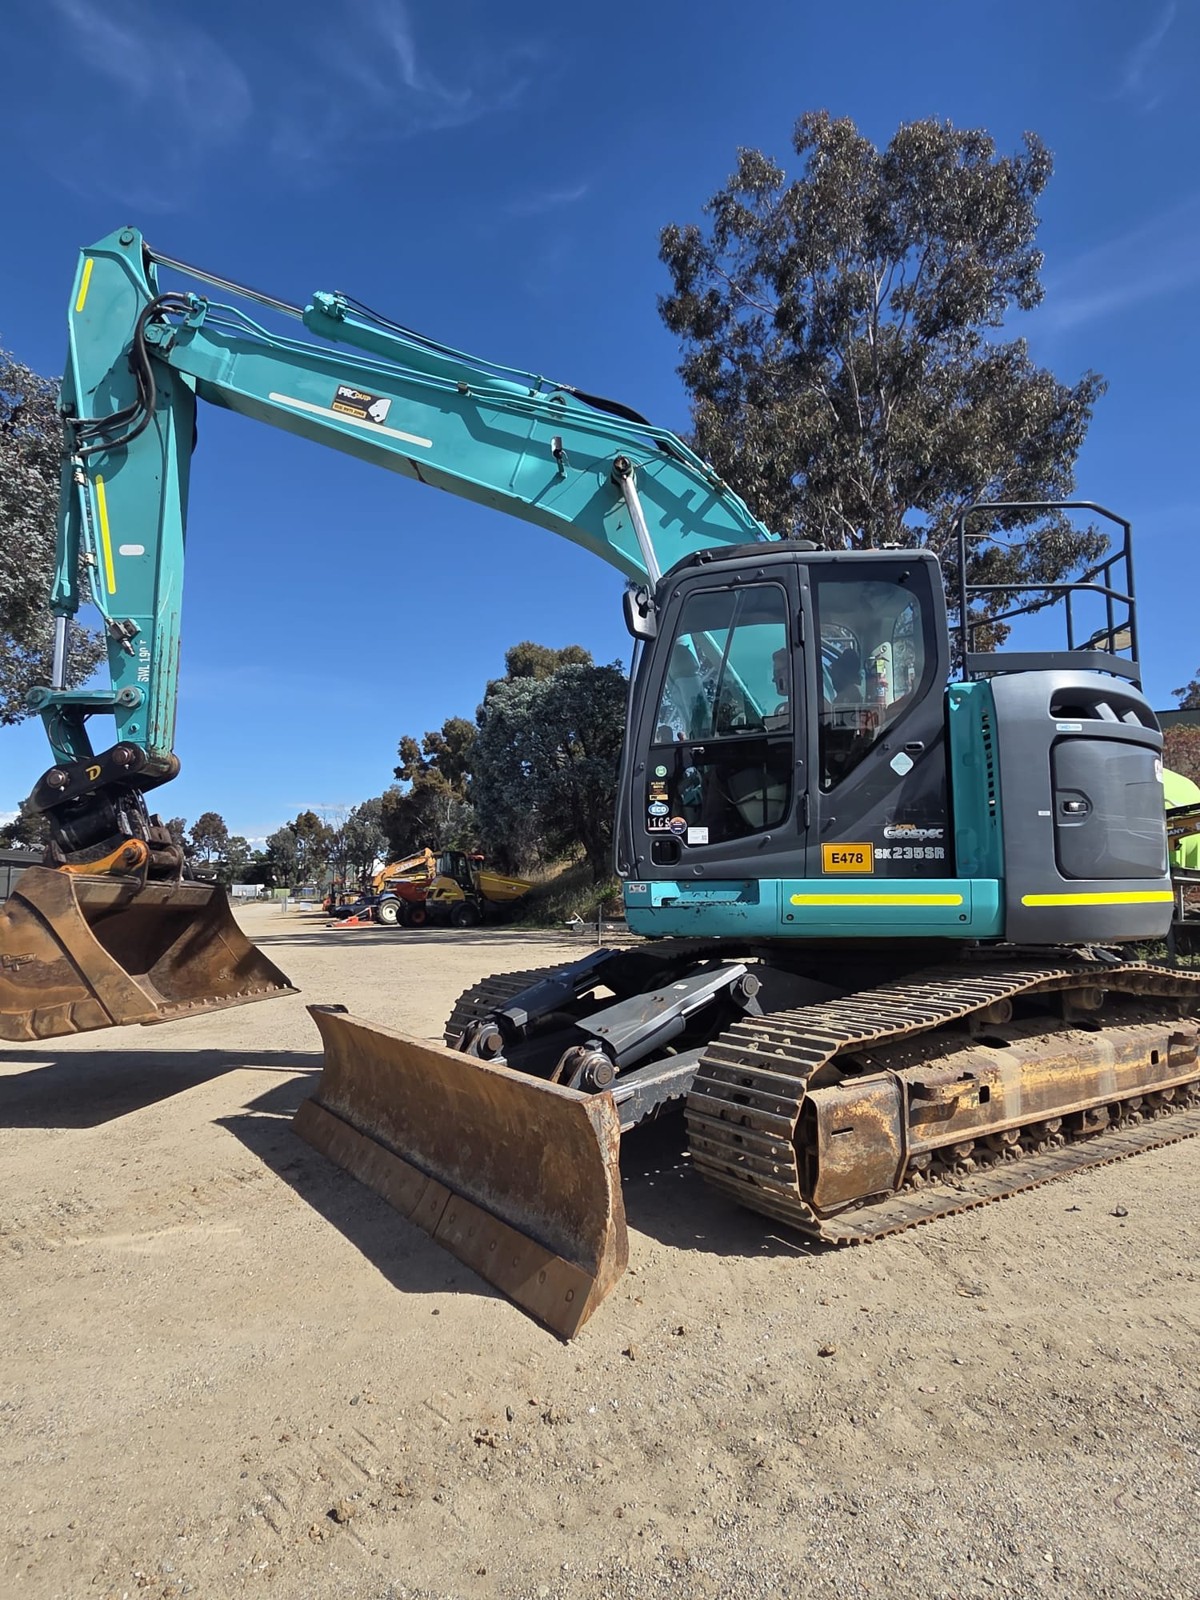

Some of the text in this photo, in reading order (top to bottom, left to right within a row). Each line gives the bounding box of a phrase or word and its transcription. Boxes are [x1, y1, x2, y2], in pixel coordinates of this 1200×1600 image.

[137, 665, 150, 682] SWL
[884, 826, 944, 841] Geospec
[831, 852, 864, 864] E478
